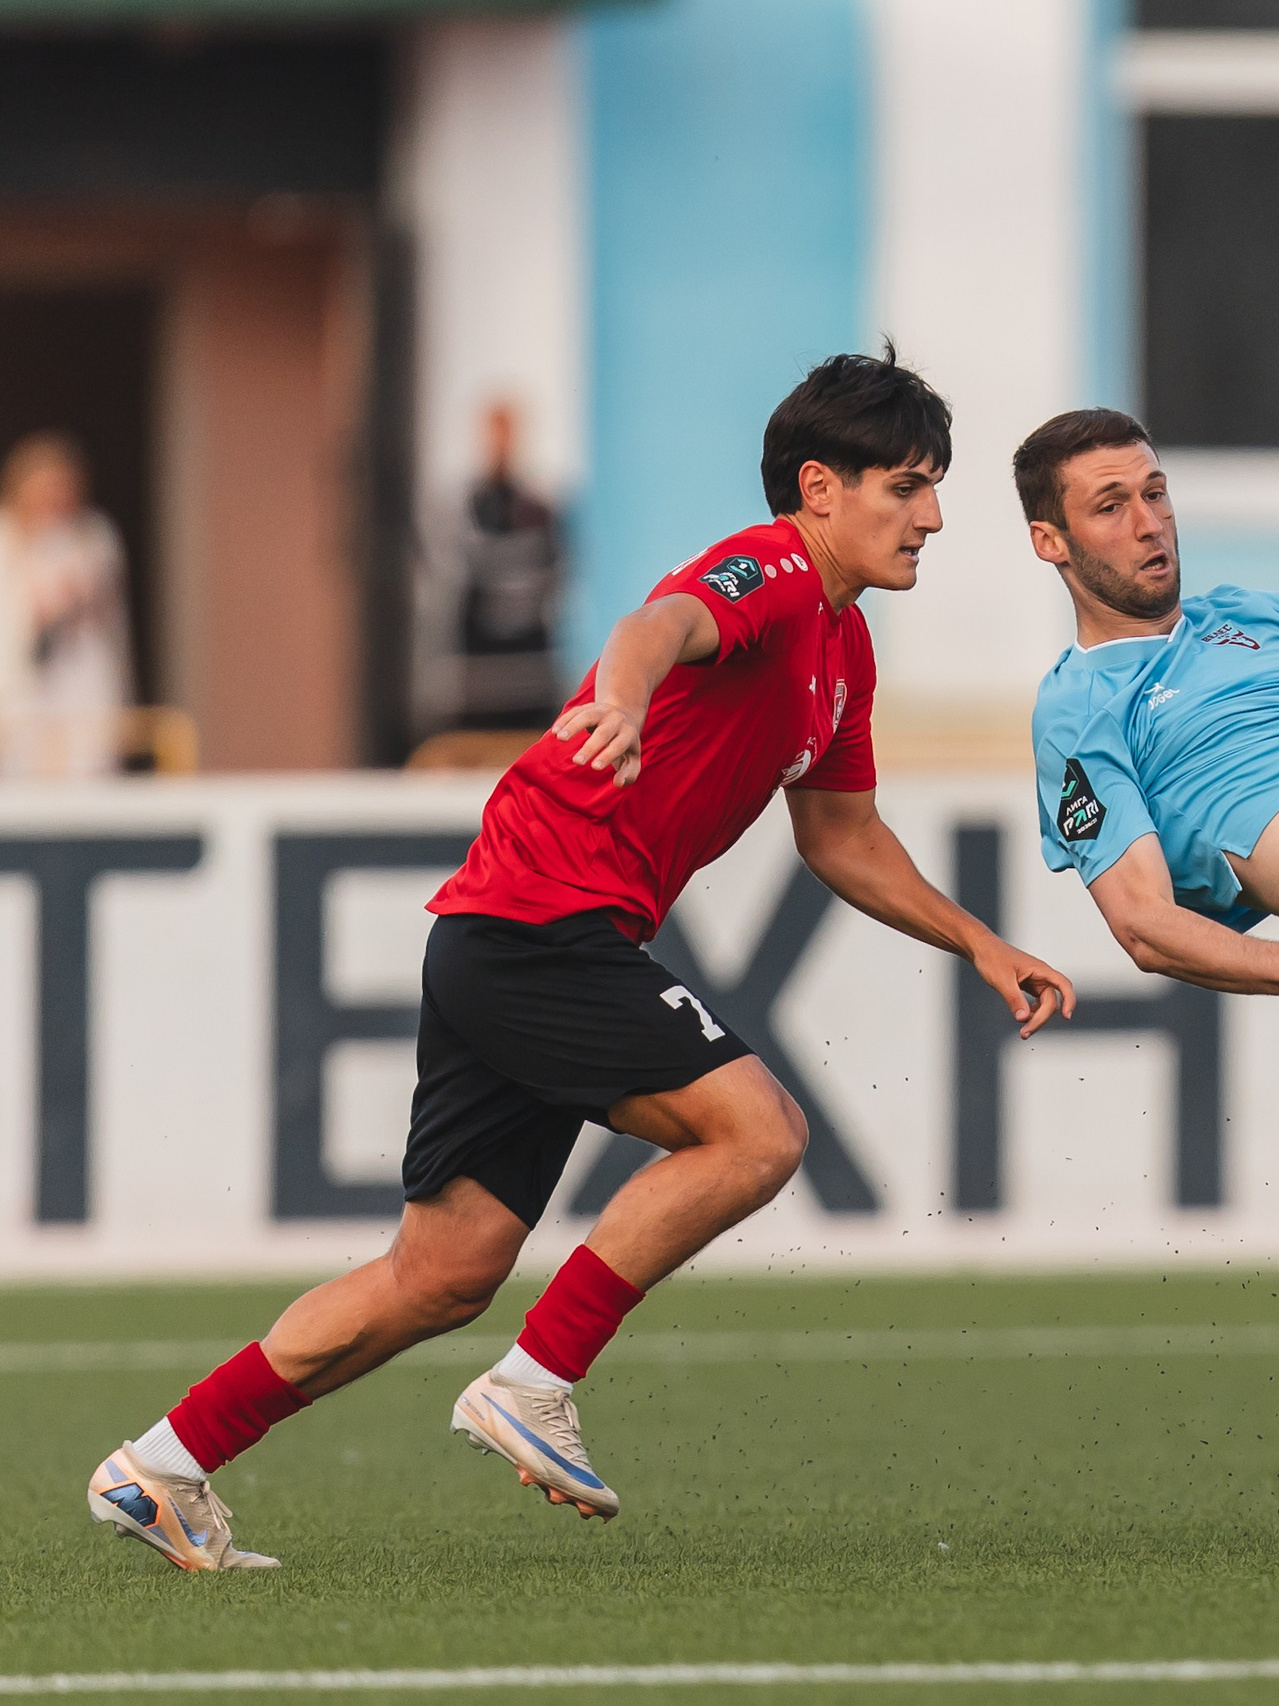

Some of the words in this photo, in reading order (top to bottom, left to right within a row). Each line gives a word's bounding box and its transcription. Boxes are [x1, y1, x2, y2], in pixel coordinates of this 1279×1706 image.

[1063, 799, 1099, 836] PARI
[1066, 795, 1088, 816] ЛИГА
[660, 985, 726, 1042] 7
